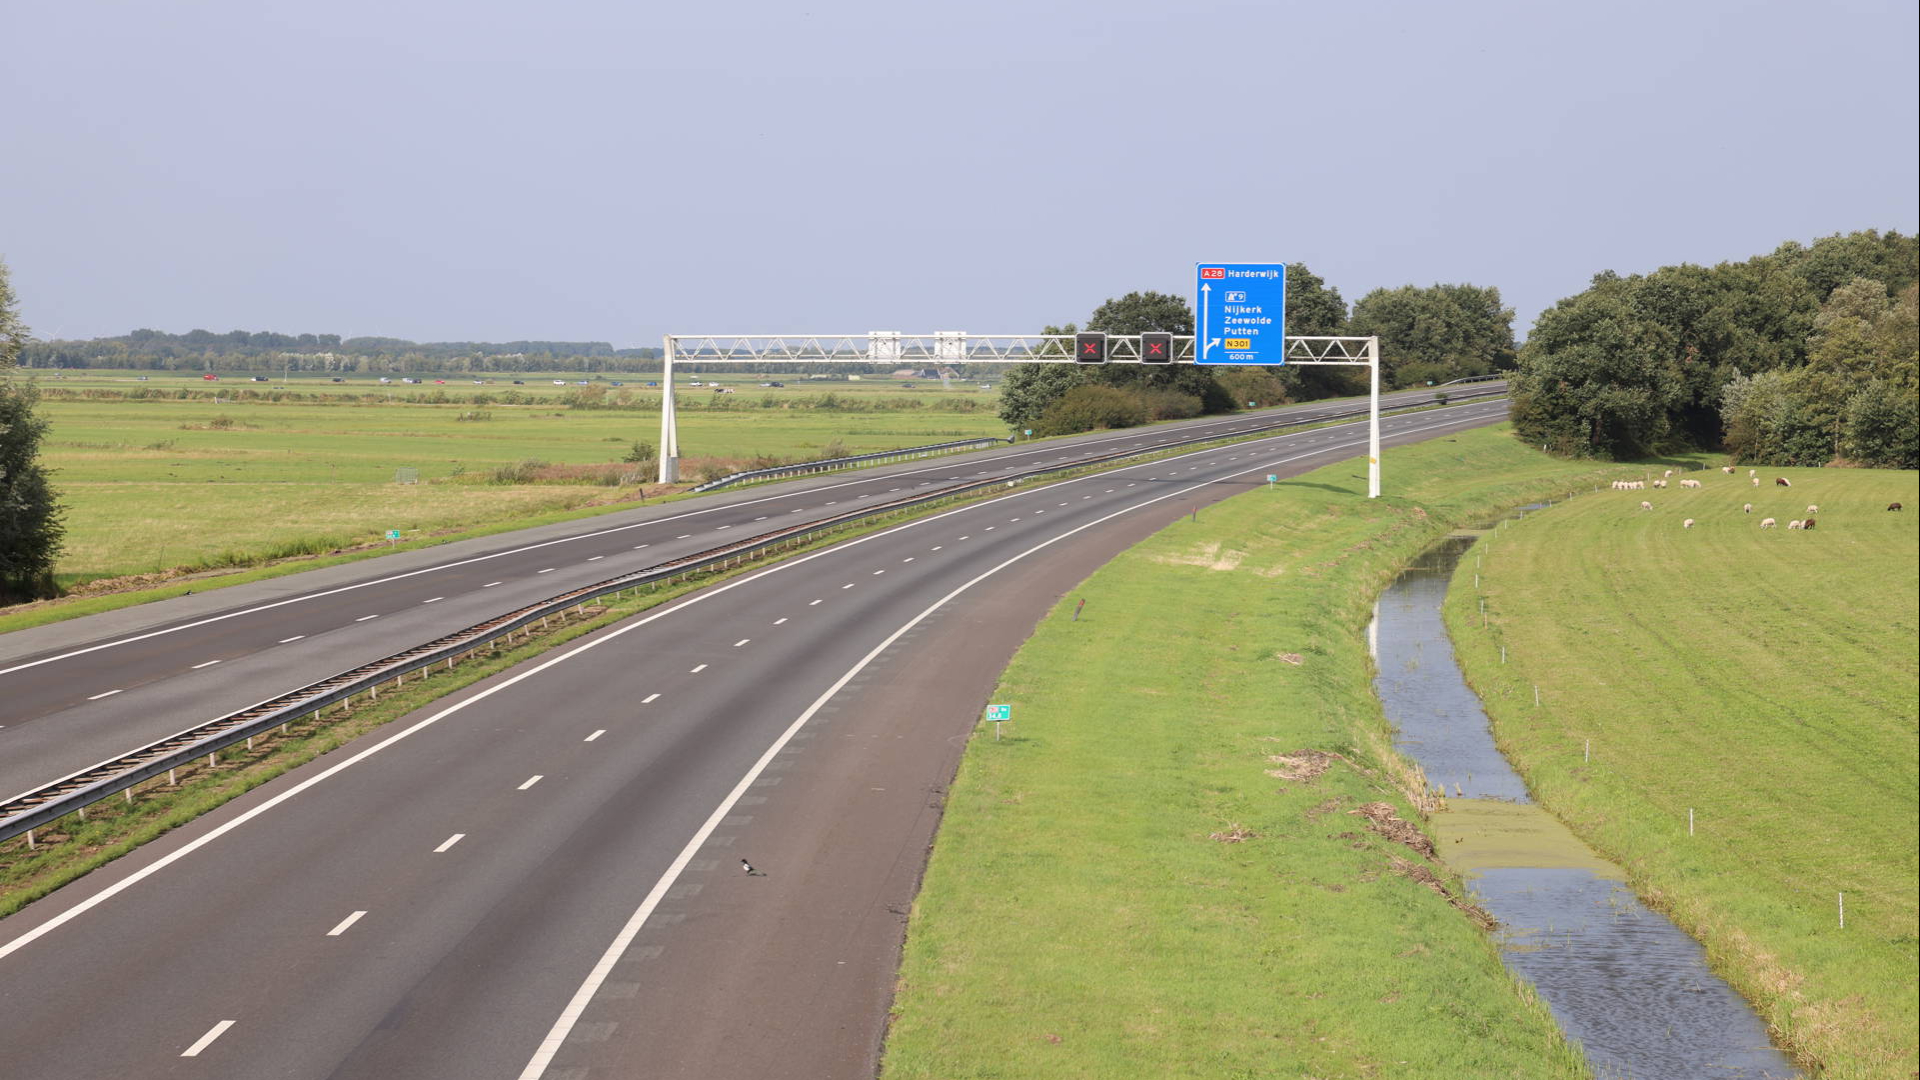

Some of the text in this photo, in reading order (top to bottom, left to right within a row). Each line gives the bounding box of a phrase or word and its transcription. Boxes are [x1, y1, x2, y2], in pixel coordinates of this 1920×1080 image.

[1228, 270, 1279, 279] Harderwijk
[1224, 306, 1262, 315] Nijkerk
[1224, 327, 1259, 335] Putten
